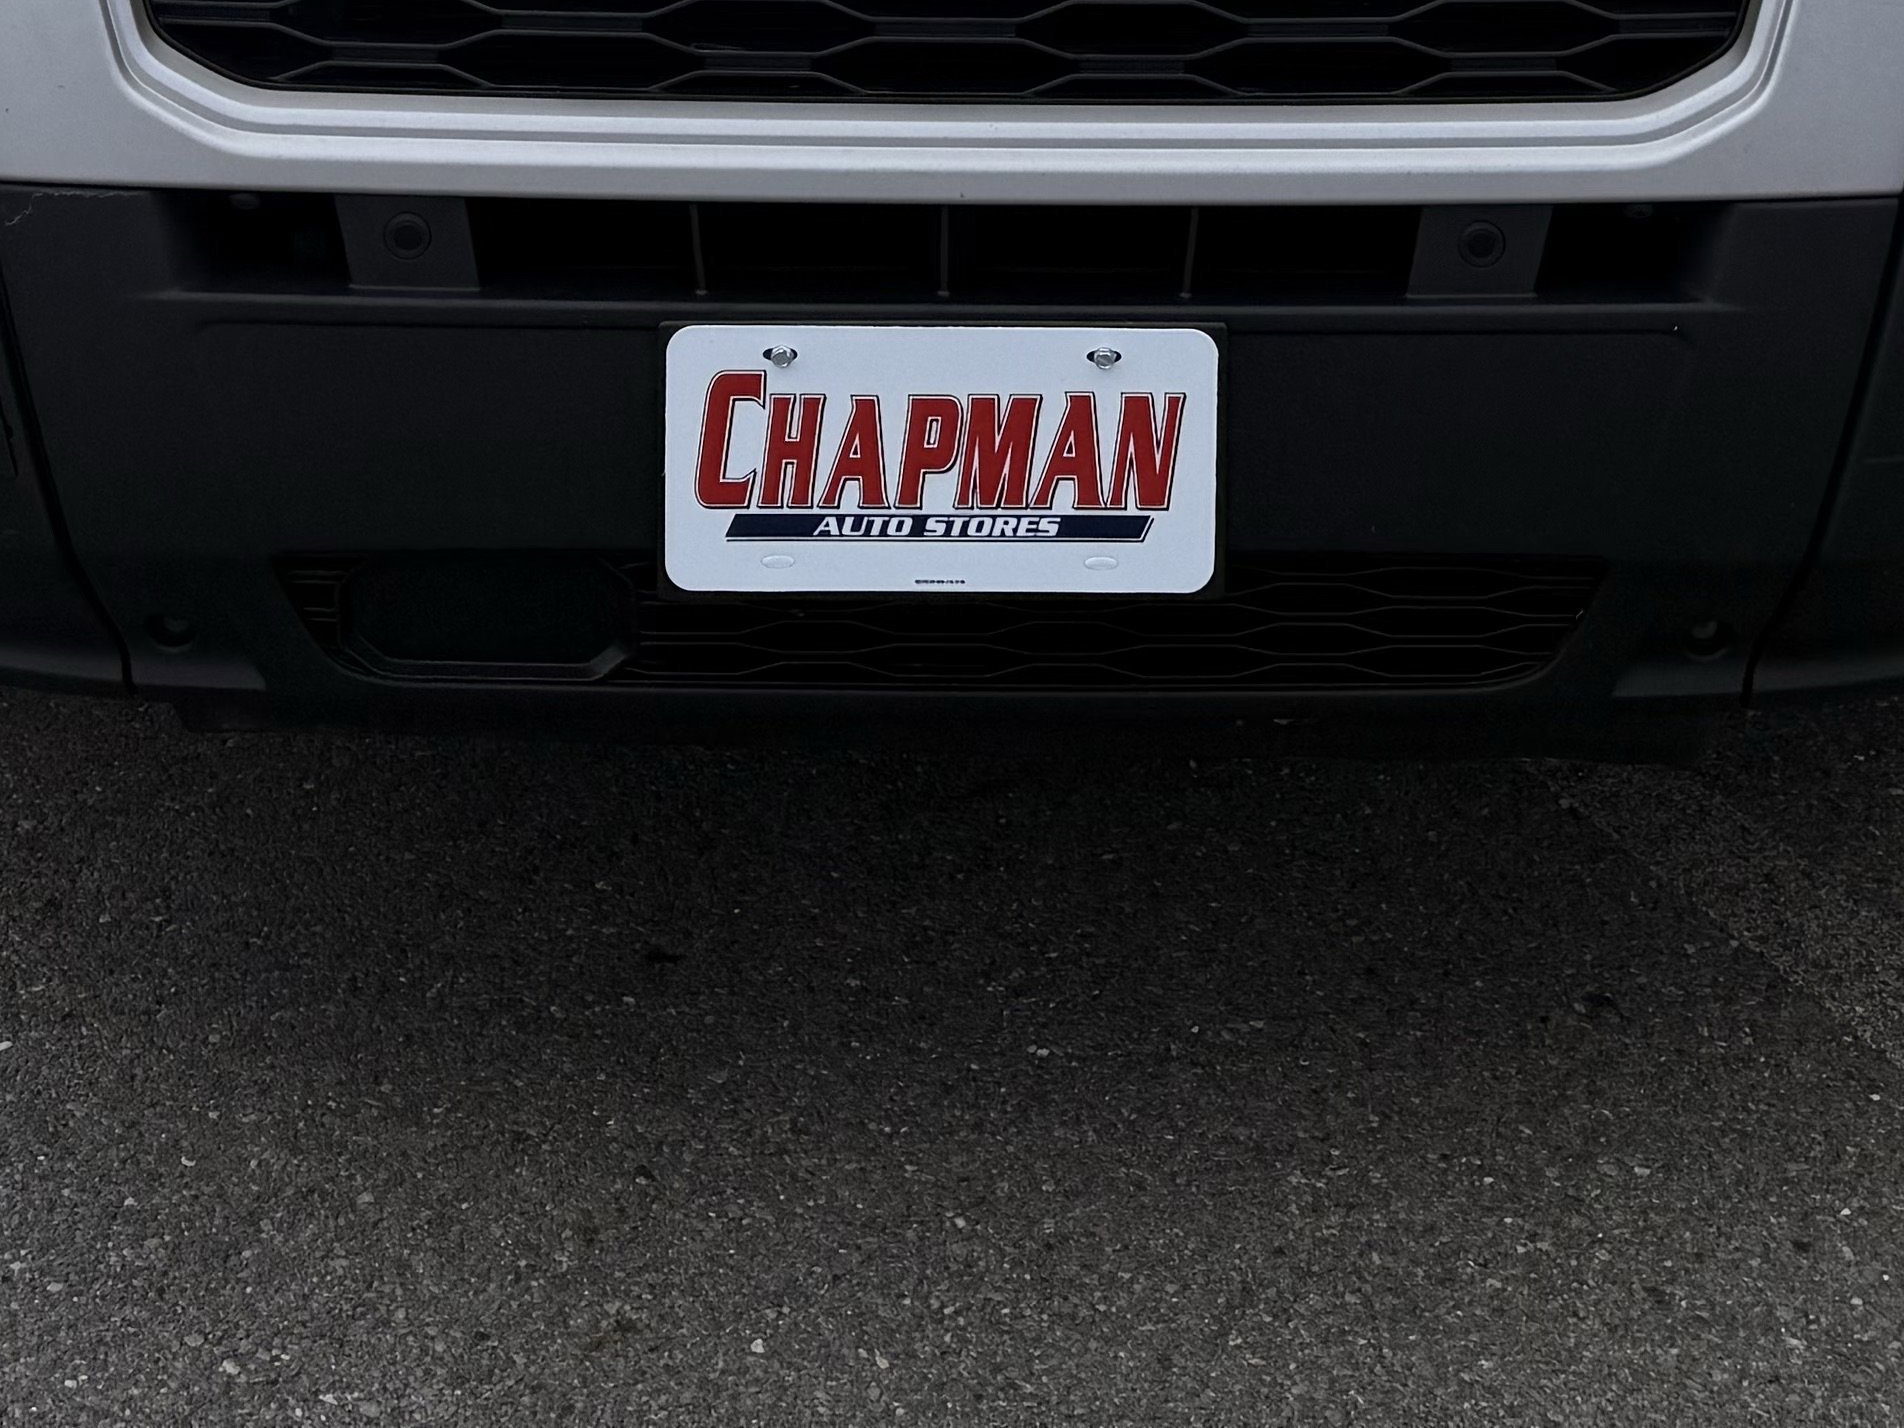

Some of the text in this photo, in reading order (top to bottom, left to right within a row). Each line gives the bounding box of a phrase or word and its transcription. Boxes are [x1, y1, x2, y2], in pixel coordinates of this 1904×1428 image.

[694, 369, 1187, 510] CHAPMAN
[813, 516, 1062, 537] AUTO STORES
